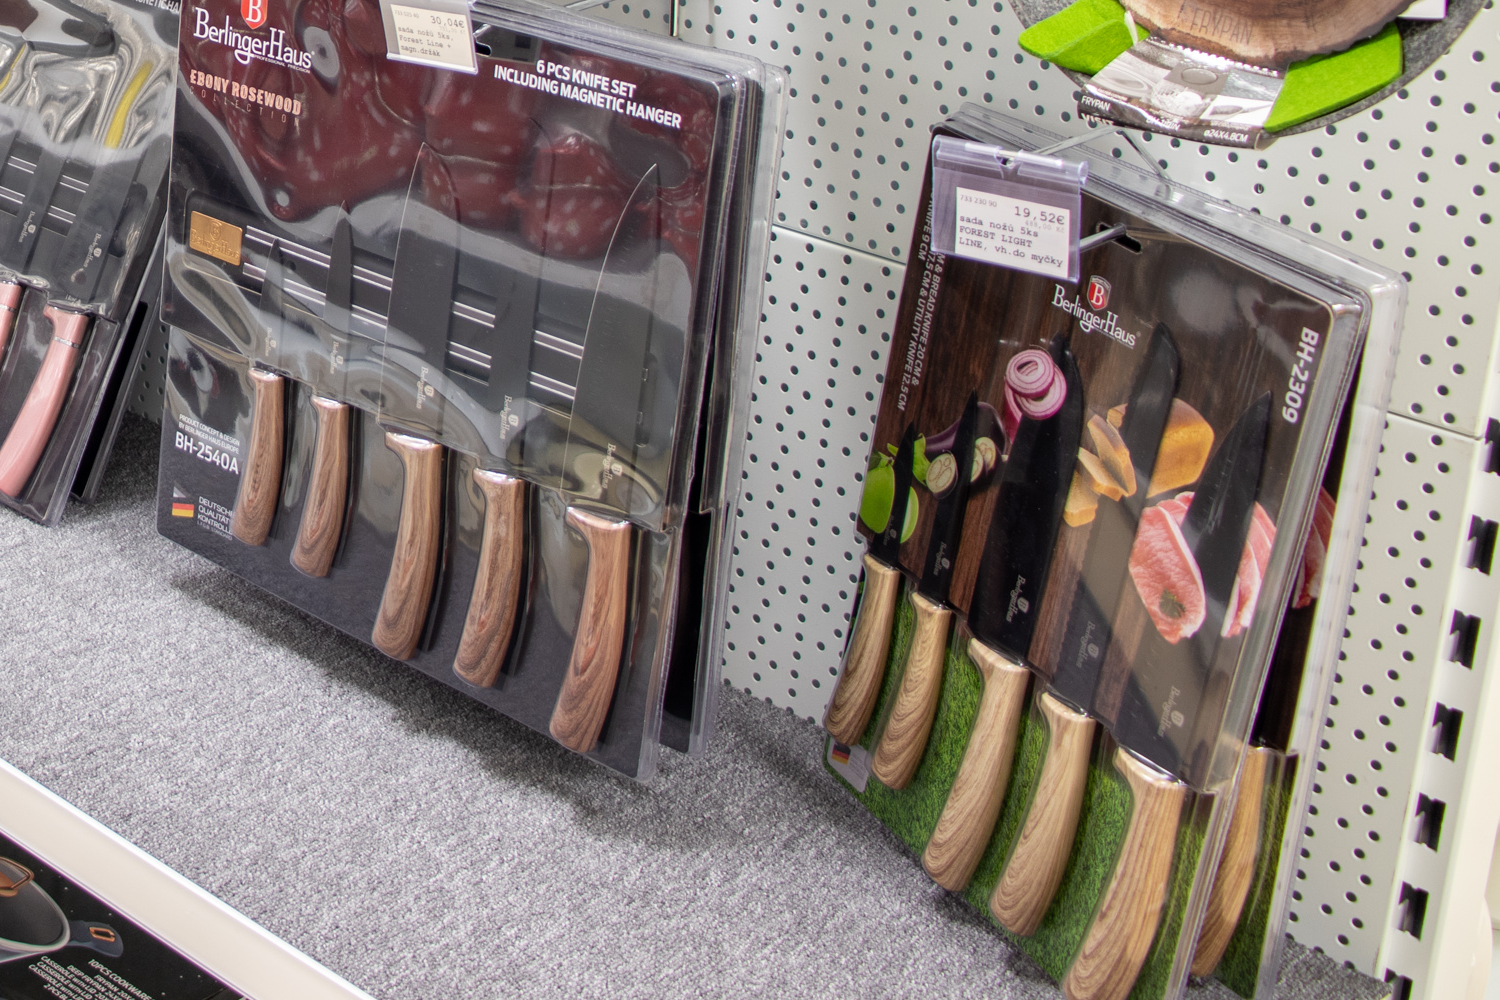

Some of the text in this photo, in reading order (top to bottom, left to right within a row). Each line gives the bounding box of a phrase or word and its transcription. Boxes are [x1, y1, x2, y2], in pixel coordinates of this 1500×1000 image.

[430, 15, 465, 29] 30,04€
[1188, 4, 1251, 46] FRYPAN
[193, 6, 312, 70] BerlingerHaus
[254, 54, 286, 68] PROFESSIONAL
[189, 68, 302, 116] EBONY ROSEWOOD
[546, 63, 636, 99] PCS KNIFE SET
[494, 64, 683, 130] INCLUDING MAGNETIC HANGER
[1081, 95, 1111, 112] FRYPAN
[959, 214, 984, 226] sada
[1020, 227, 1039, 238] 5ks
[1013, 206, 1066, 226] 19,52€
[959, 226, 1033, 249] FOREST LIGHT
[1030, 251, 1064, 268] myčky
[927, 274, 942, 312] BREAD
[1051, 283, 1137, 347] BerlingerHaus
[905, 299, 926, 372] UTILITY KNIFE
[1281, 326, 1320, 424] BH-2309
[179, 413, 220, 438] PRODUCT CONCEPT
[184, 424, 209, 441] BERLINGER
[174, 430, 239, 475] BH-2540A
[28, 963, 62, 988] CASSEROLE
[36, 961, 71, 986] CASSEROLE
[40, 955, 76, 980] CASSEROLE
[66, 964, 106, 994] DEEP FRYPAN
[87, 958, 112, 977] 10PCS
[94, 974, 120, 994] FRYPAN
